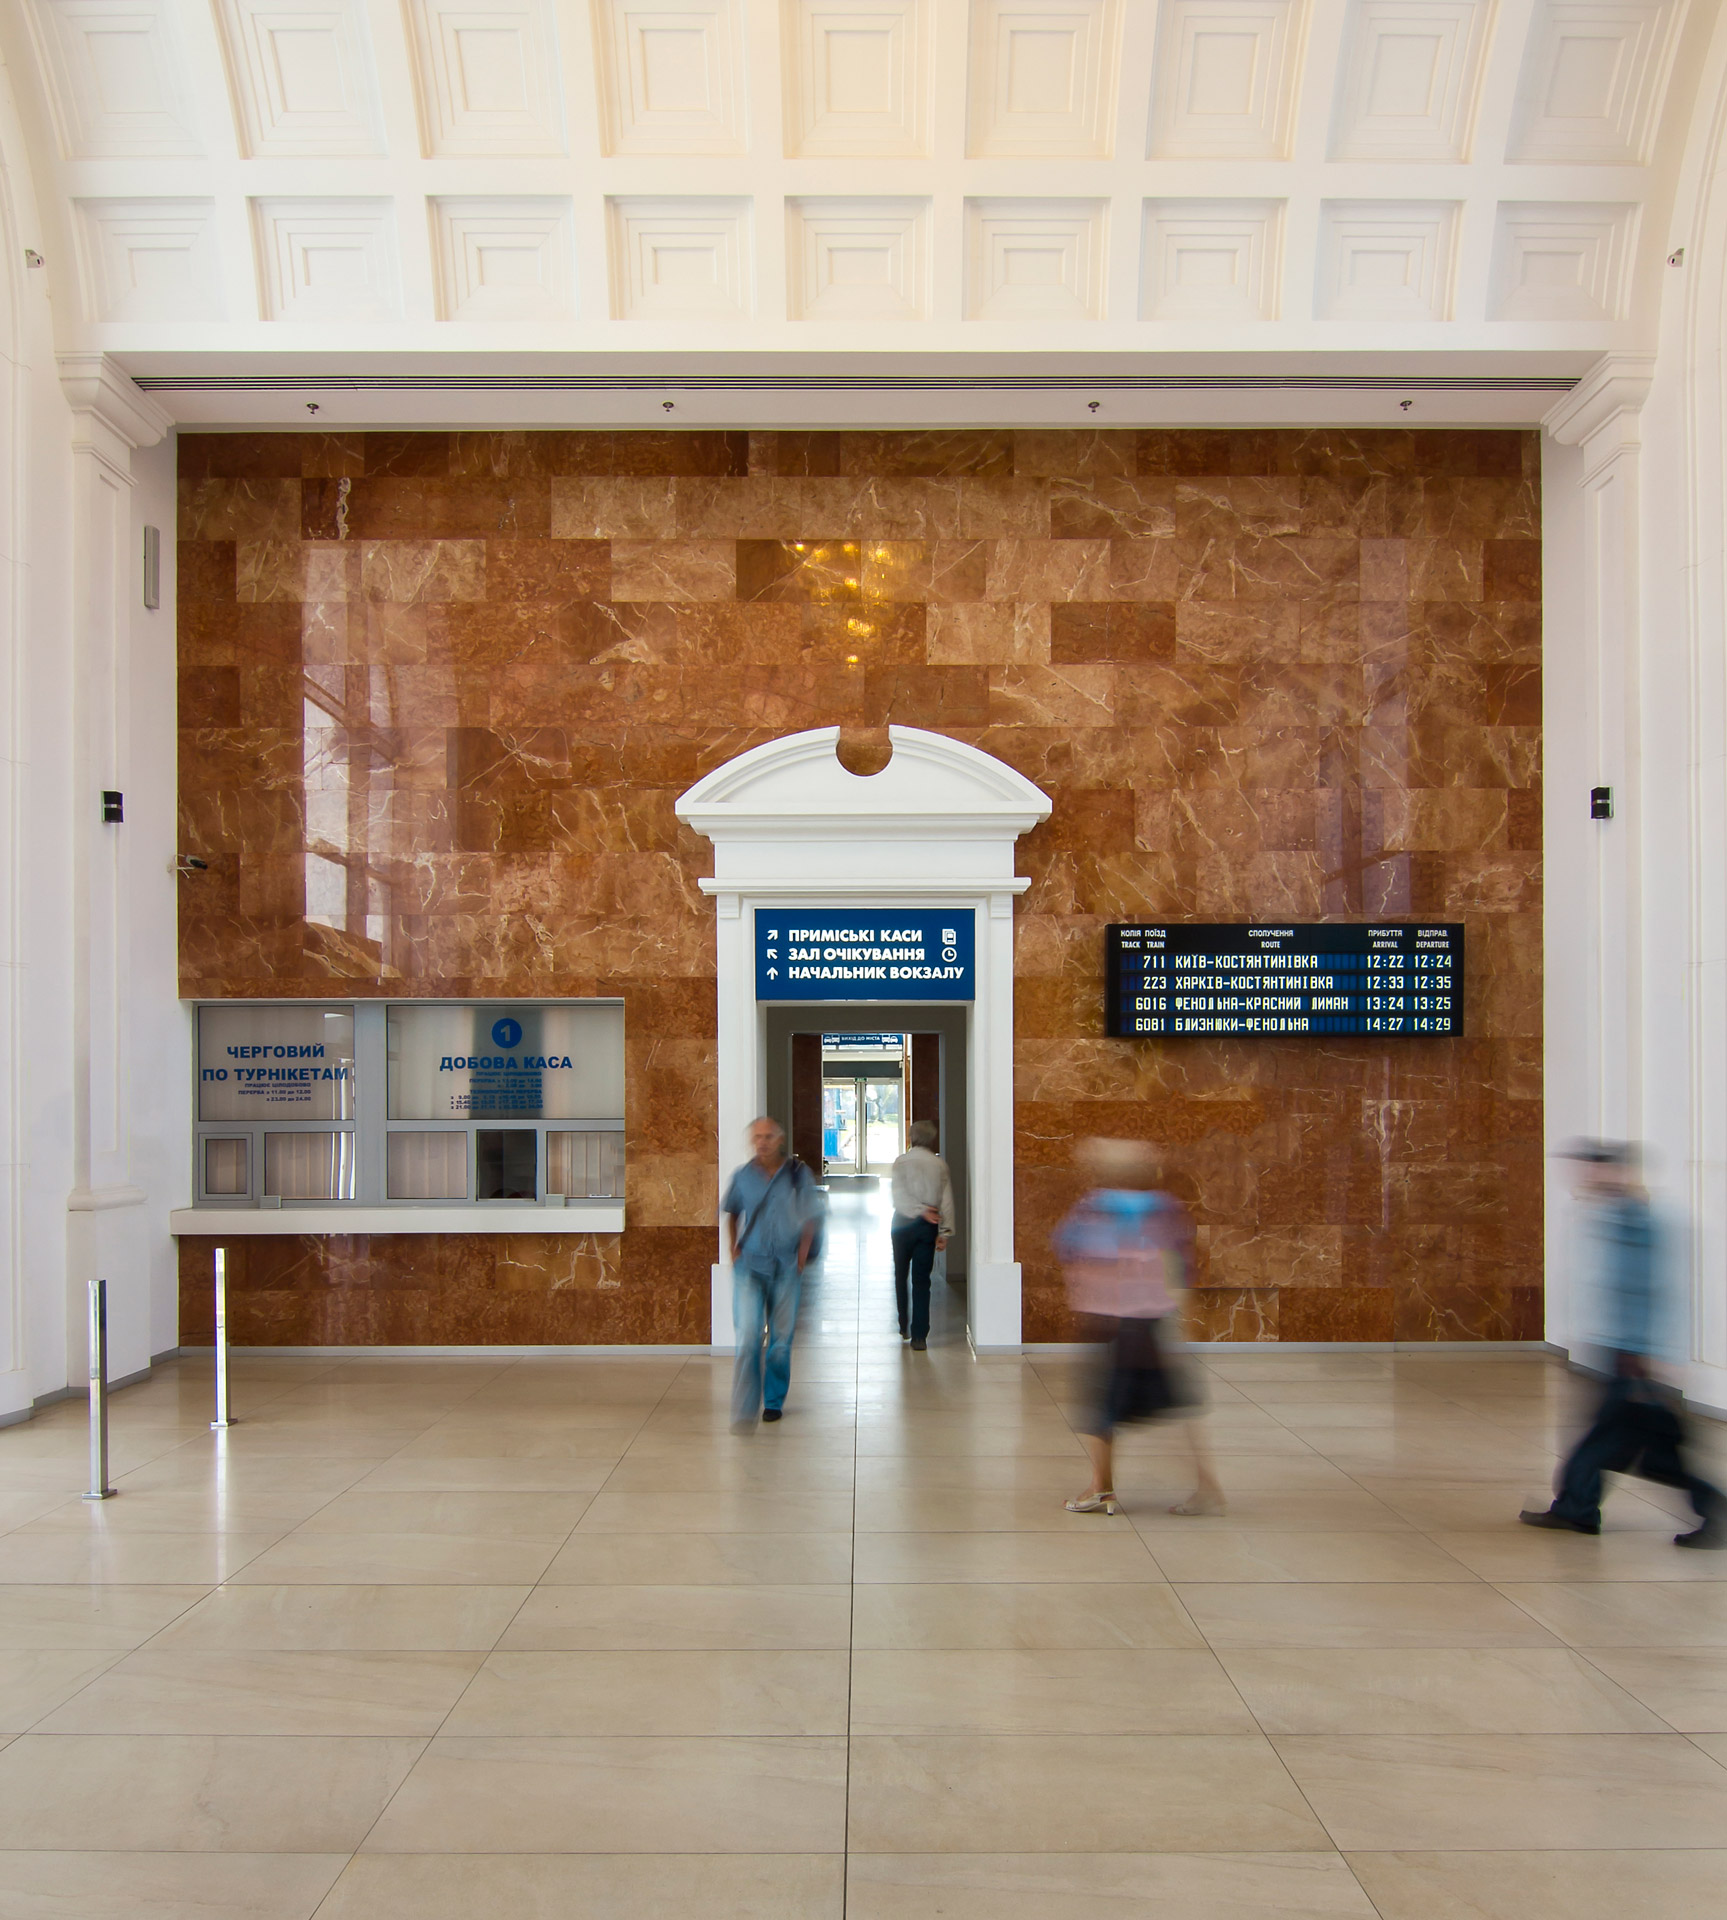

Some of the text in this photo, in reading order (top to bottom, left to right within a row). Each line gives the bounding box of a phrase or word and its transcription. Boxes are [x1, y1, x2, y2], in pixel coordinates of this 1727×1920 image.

[789, 930, 922, 941] ПРИМІСЬКІ КАСИ
[1145, 929, 1166, 937] ПОЇЗД
[788, 948, 925, 960] ЗАЛ ОЧІКУВАННЯ
[1143, 954, 1451, 968] 711 КИЇВ-КОСТЯНТИНІВКА 12:22 12:24
[789, 967, 964, 979] НАЧАЛЬНИК ВОКЗАЛУ
[1143, 976, 1451, 989] 223 ХАРКІВ-КОСТЯНТИНІВКА 12:33 12:35
[1136, 997, 1166, 1010] 6016
[1312, 997, 1348, 1010] ЛИМАН
[1367, 997, 1403, 1010] 13:24
[1414, 997, 1451, 1010] 13:25
[1136, 1018, 1165, 1031] 6081
[1367, 1018, 1403, 1030] 14:27
[1414, 1018, 1451, 1030] 14:29
[500, 1025, 511, 1041] 1
[227, 1043, 324, 1058] ЧЕРГОВИЙ
[440, 1057, 572, 1071] ДОБОВА КАСА
[202, 1068, 348, 1081] ПО ТУРНІКЕТАМ
